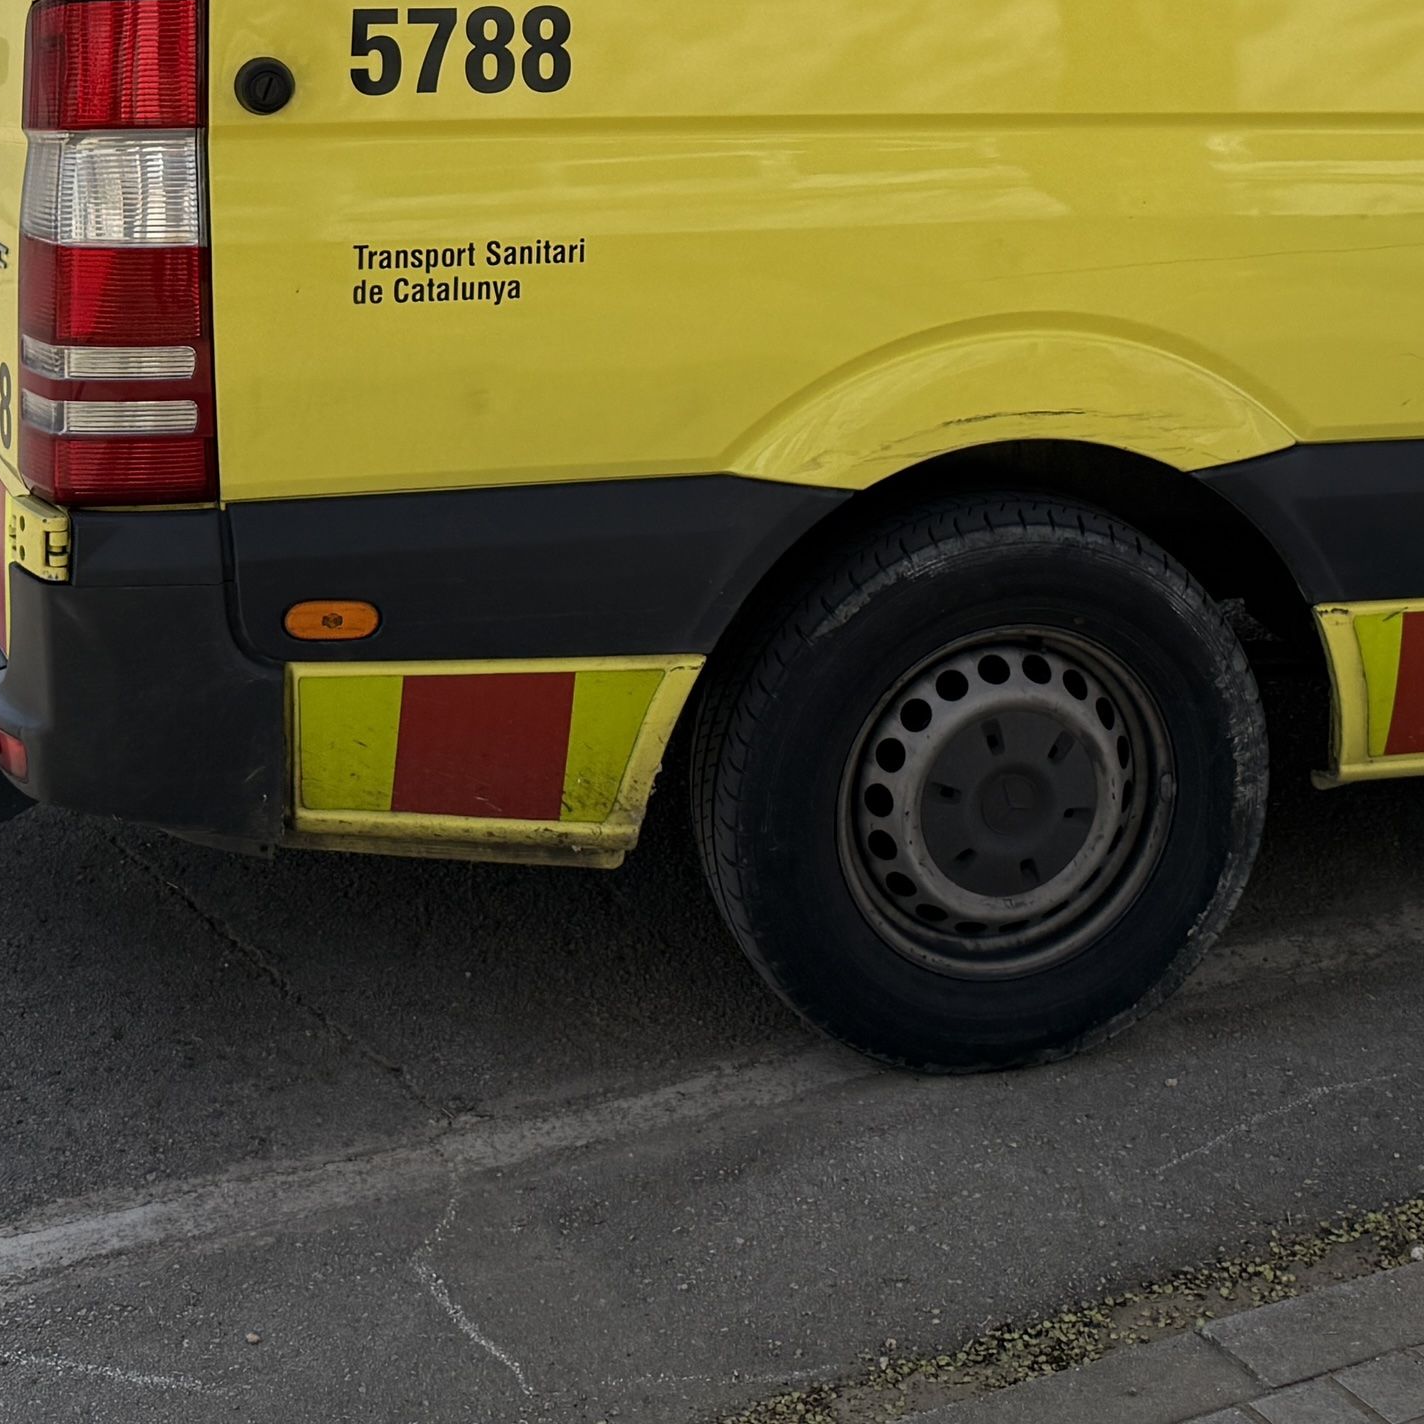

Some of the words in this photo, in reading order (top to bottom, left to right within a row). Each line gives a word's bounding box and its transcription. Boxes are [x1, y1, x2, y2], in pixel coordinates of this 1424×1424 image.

[350, 5, 571, 96] 5788
[353, 242, 475, 273] Transport
[486, 238, 586, 267] Sanitari
[353, 279, 383, 304] de
[393, 276, 522, 305] Catalunya
